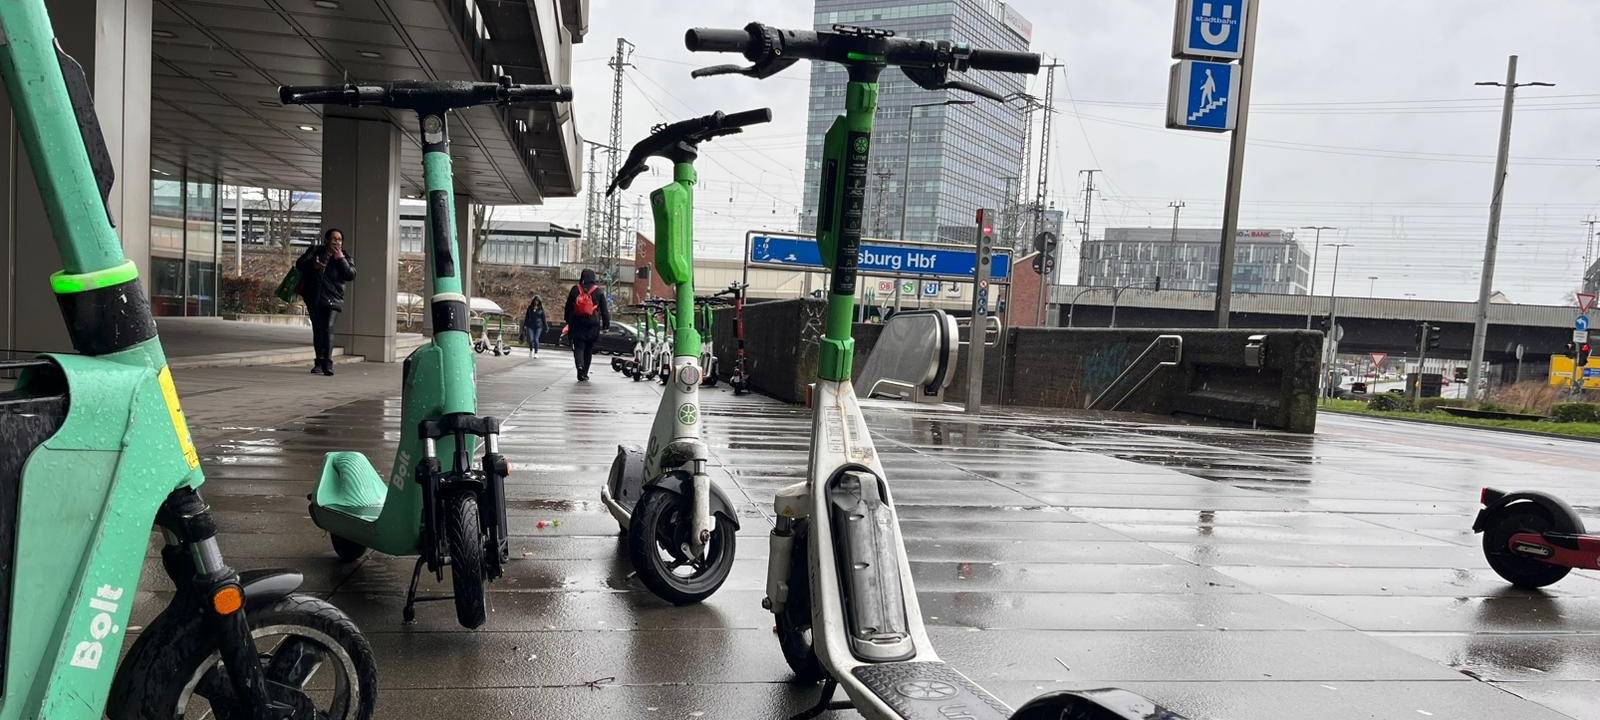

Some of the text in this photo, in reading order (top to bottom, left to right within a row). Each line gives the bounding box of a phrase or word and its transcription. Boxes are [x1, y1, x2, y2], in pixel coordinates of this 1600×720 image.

[1195, 16, 1237, 25] stadtbahn
[907, 253, 937, 269] Hbf
[393, 450, 410, 490] Bolt
[69, 584, 124, 670] Bolt
